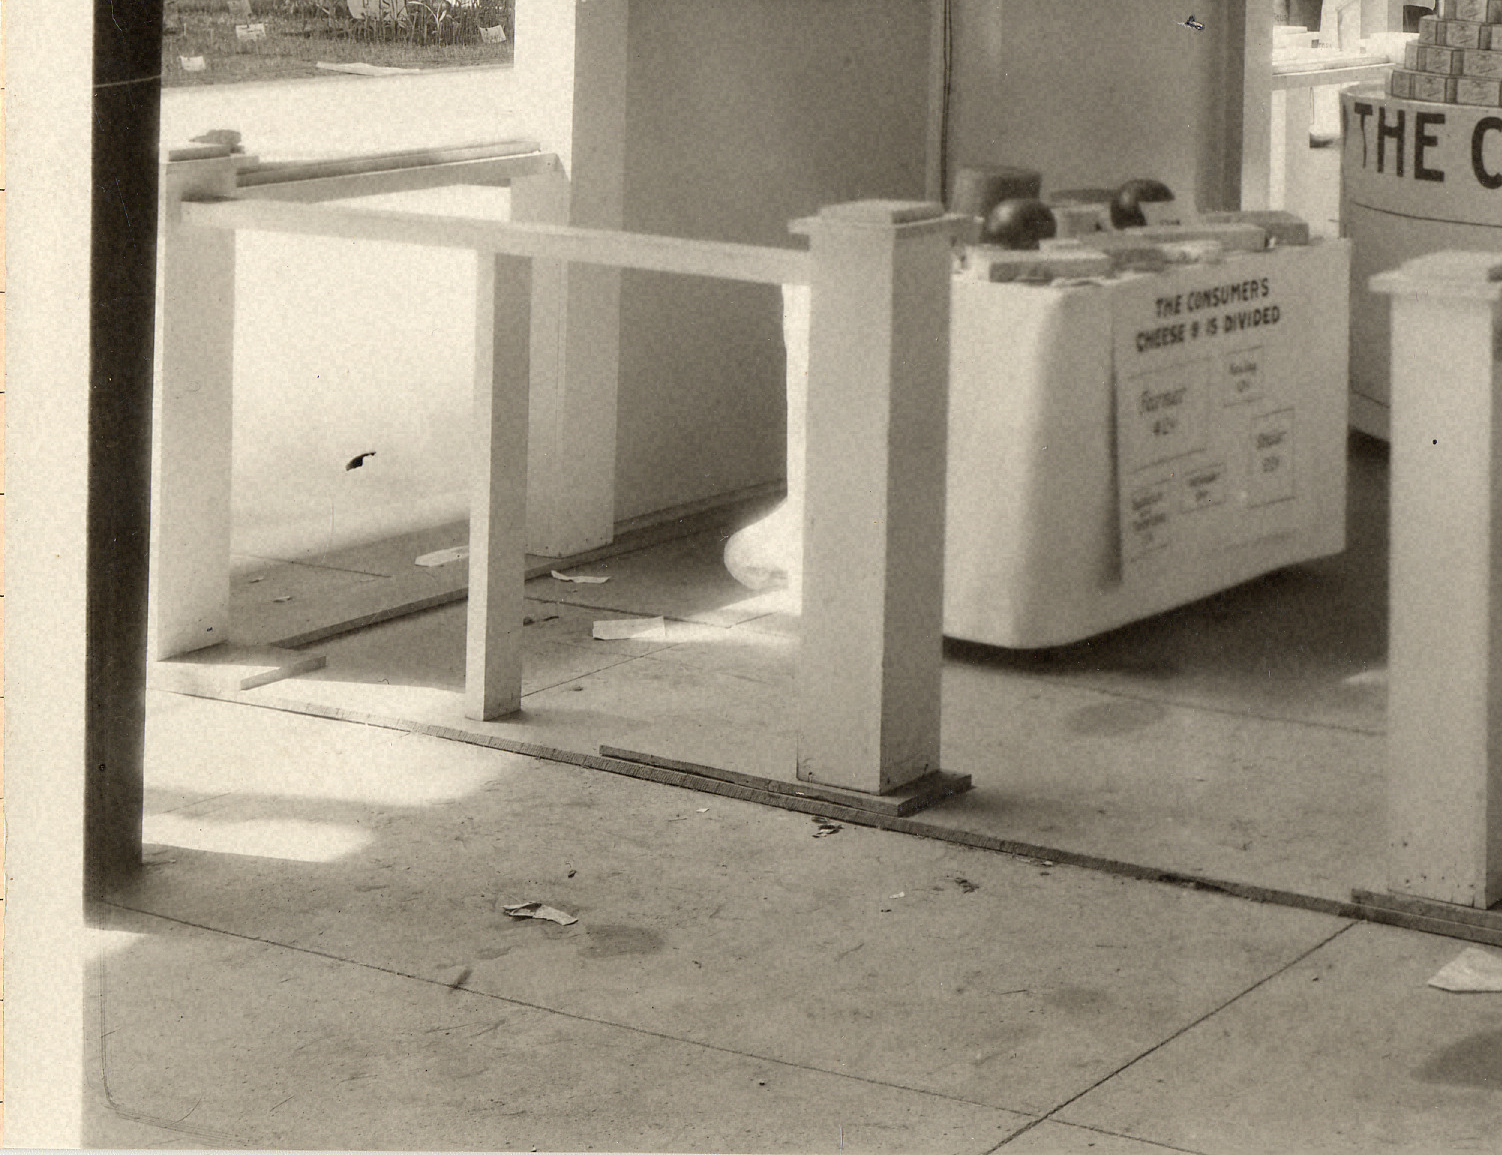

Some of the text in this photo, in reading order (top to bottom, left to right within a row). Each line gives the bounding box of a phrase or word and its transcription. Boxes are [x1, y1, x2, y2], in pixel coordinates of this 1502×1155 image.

[1354, 102, 1446, 182] THE
[1136, 323, 1185, 352] CHEESE
[1206, 317, 1218, 336] IS
[1224, 305, 1280, 333] DIVIDED
[1155, 295, 1182, 317] THE
